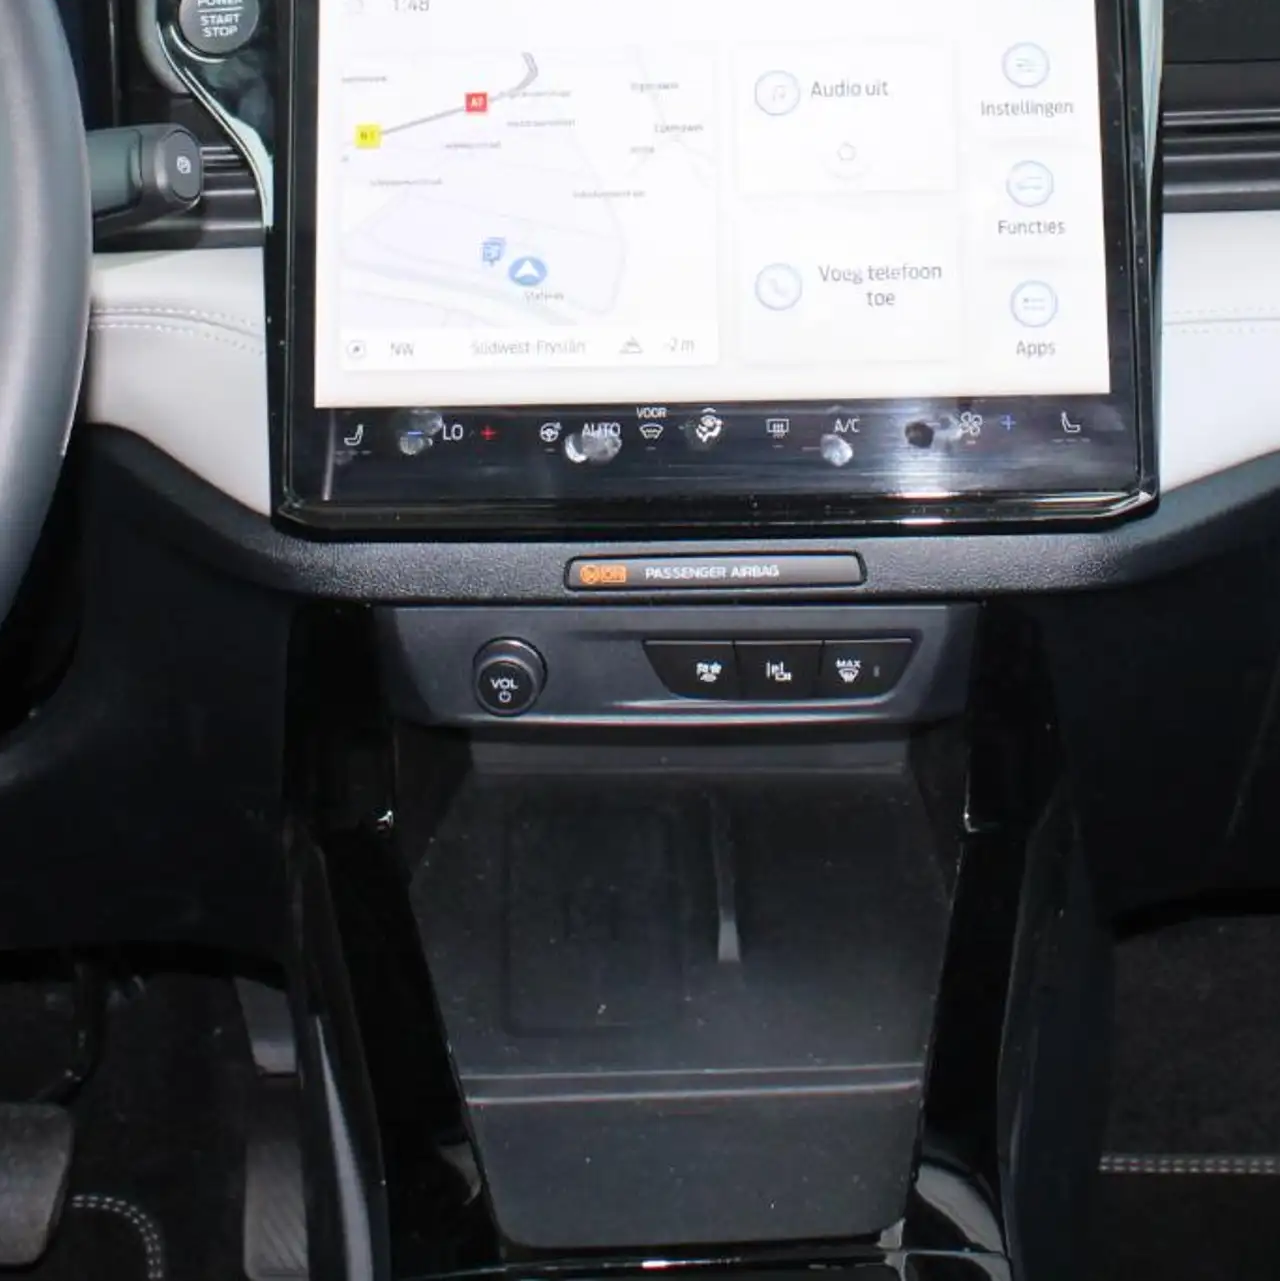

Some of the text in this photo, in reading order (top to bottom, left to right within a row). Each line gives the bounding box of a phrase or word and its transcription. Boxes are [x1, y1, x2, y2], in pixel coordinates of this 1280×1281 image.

[200, 13, 241, 26] START
[202, 25, 239, 38] STOP
[811, 81, 888, 97] Audio uit
[980, 100, 1074, 117] Instellingen
[997, 220, 1066, 235] Functies
[818, 265, 943, 285] Voeg telefoon
[866, 290, 896, 307] toe
[1016, 340, 1056, 358] Apps
[636, 407, 667, 418] VOOR
[442, 423, 464, 441] LO
[582, 422, 621, 438] AUTO
[834, 418, 860, 433] A/C
[645, 567, 727, 580] PASSENGER
[730, 565, 780, 578] AIRBAG
[836, 659, 861, 668] MAX
[491, 678, 518, 690] VOL
